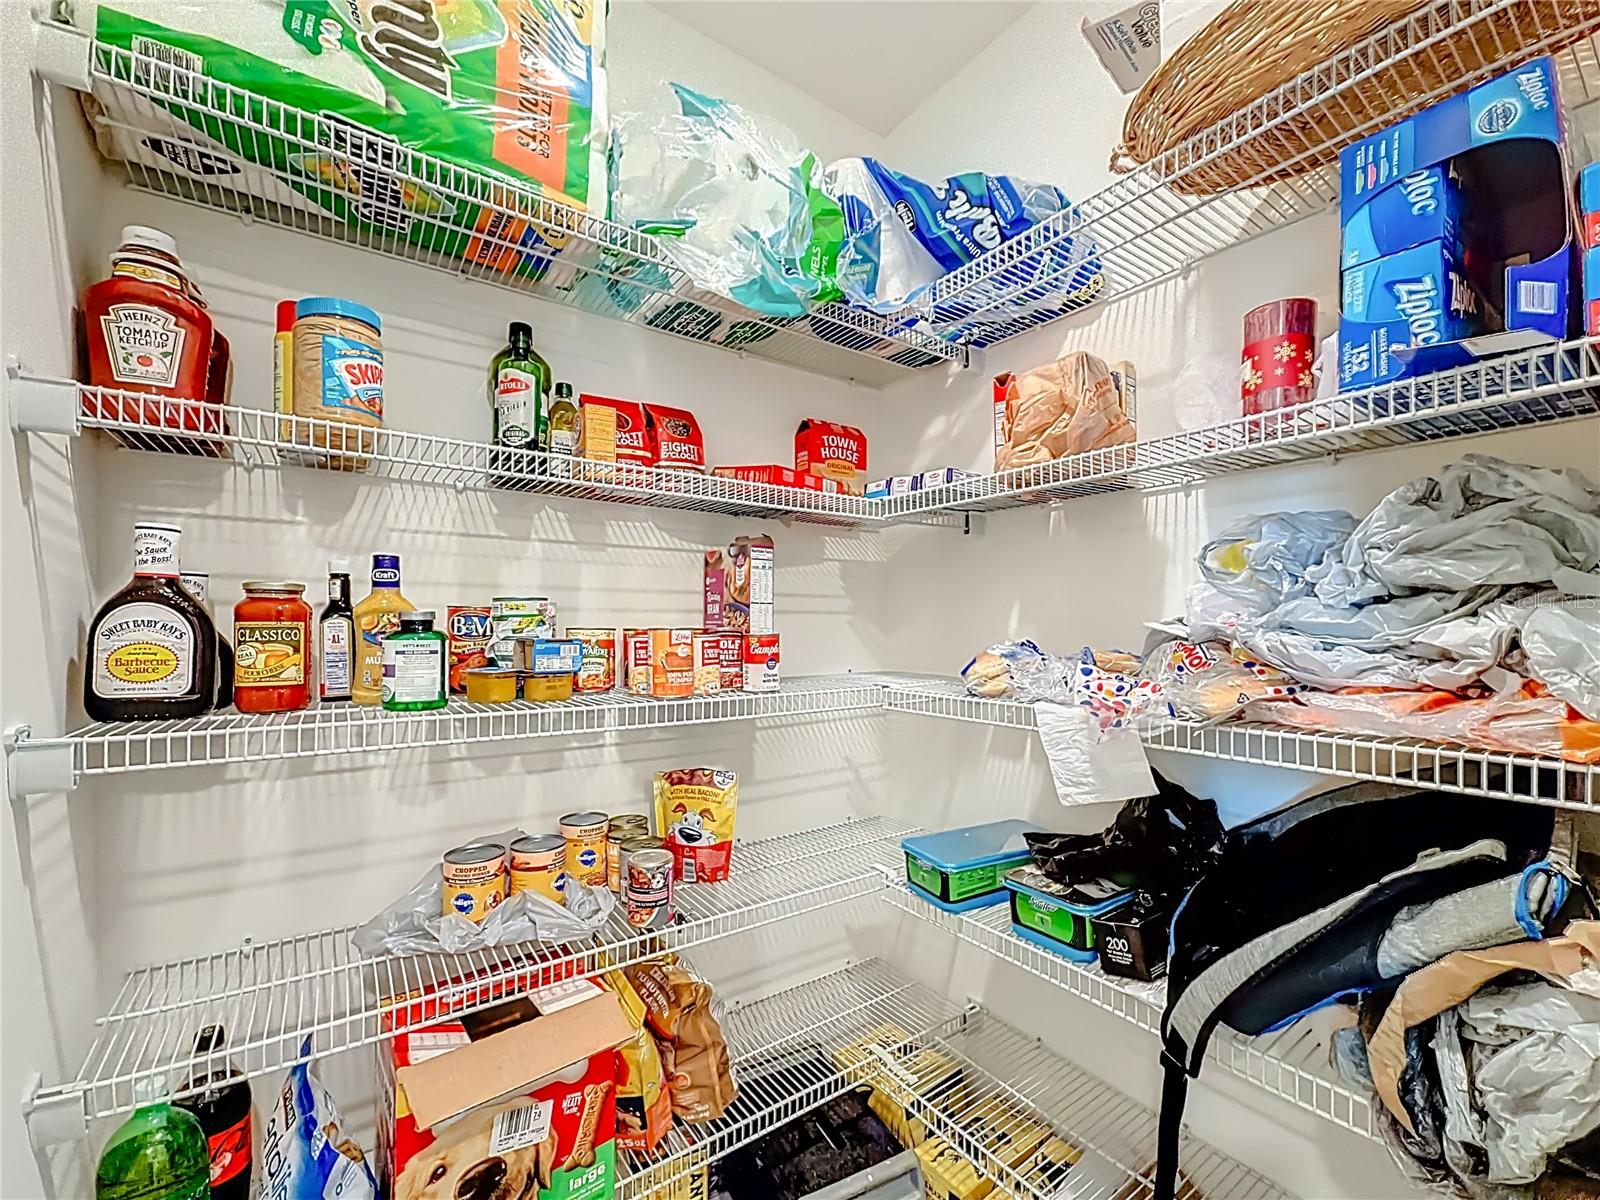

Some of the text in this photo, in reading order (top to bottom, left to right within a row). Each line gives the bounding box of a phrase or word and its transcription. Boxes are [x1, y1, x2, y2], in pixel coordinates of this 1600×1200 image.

[1515, 66, 1550, 110] Ziploc
[1393, 272, 1444, 347] Ziploc
[122, 312, 162, 326] HEINZ
[115, 325, 170, 342] TOMATO
[118, 335, 169, 349] KETCHUP
[1352, 343, 1371, 375] 152
[660, 441, 698, 457] EIGHT
[821, 435, 858, 451] TOWN
[660, 451, 695, 461] O'CLOCK
[820, 447, 860, 464] HOUSE
[826, 462, 853, 471] ORIGINAL
[143, 546, 168, 555] Sauce
[150, 554, 172, 564] Boss!
[374, 570, 396, 580] Kraft
[100, 619, 187, 641] SWEET BABY RAY'S
[453, 616, 493, 637] B&M
[238, 629, 300, 641] CLASSICO
[114, 657, 170, 667] Barbecue
[123, 666, 160, 677] Sauce
[579, 825, 604, 835] CHOPPED
[454, 865, 488, 875] CHOPPED
[1105, 936, 1129, 952] 200
[561, 1096, 583, 1109] MEATY
[563, 1105, 579, 1116] Taste
[568, 1164, 606, 1192] large
